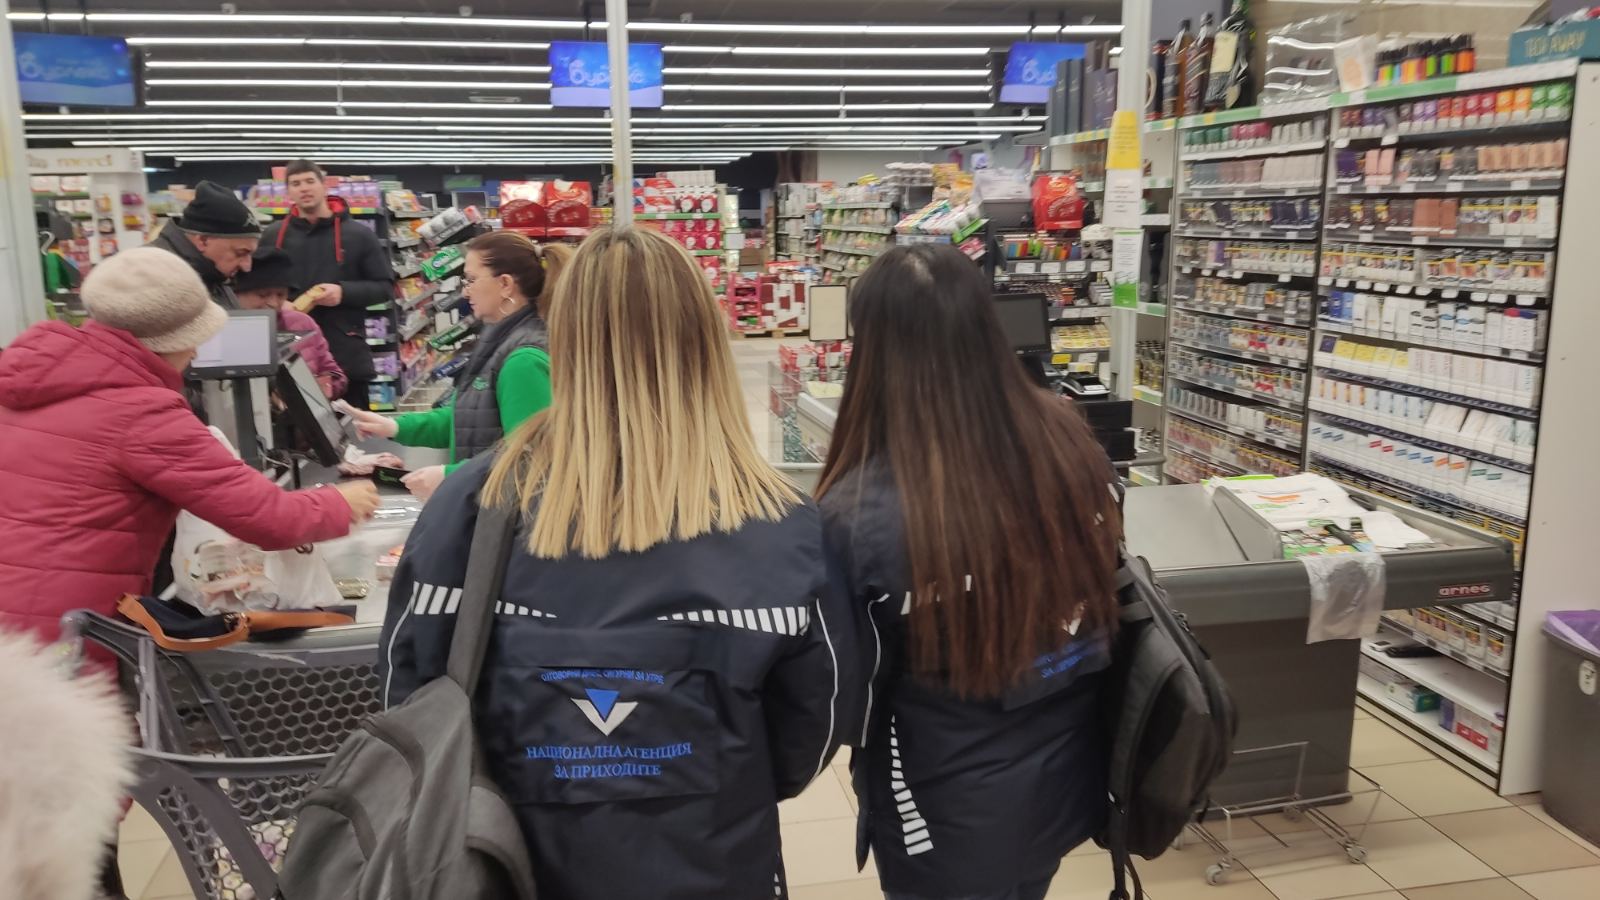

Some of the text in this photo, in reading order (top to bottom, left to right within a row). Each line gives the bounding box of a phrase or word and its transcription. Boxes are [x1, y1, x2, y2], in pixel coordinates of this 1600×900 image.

[526, 742, 693, 761] НАЦИОНАЛНА АГЕНЦИЯ
[554, 763, 662, 780] ЗА ПРИХОДИТЕ
